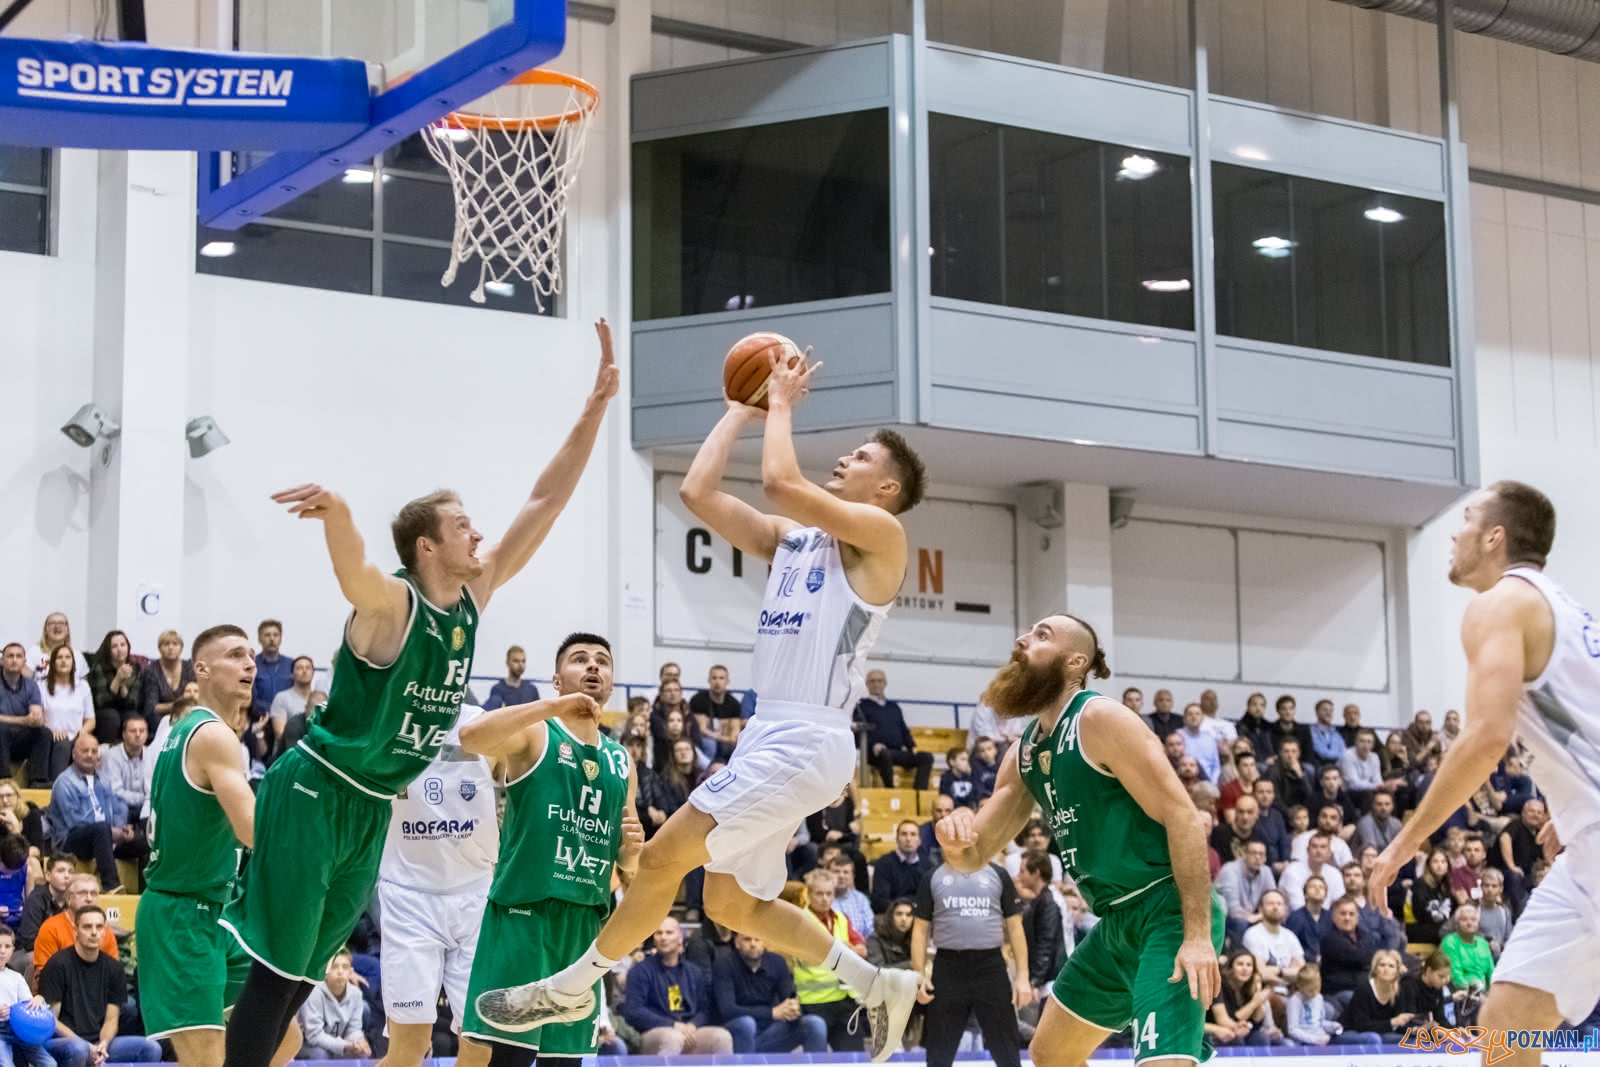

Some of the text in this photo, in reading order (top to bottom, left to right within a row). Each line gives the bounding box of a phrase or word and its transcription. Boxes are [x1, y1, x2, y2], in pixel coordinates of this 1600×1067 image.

[17, 57, 293, 105] SPORT SYSTEM
[141, 592, 160, 616] C
[895, 596, 945, 610] ORTOWY
[1056, 712, 1079, 755] 24
[602, 747, 629, 780] 13
[424, 777, 444, 805] 8
[392, 1000, 424, 1009] macron
